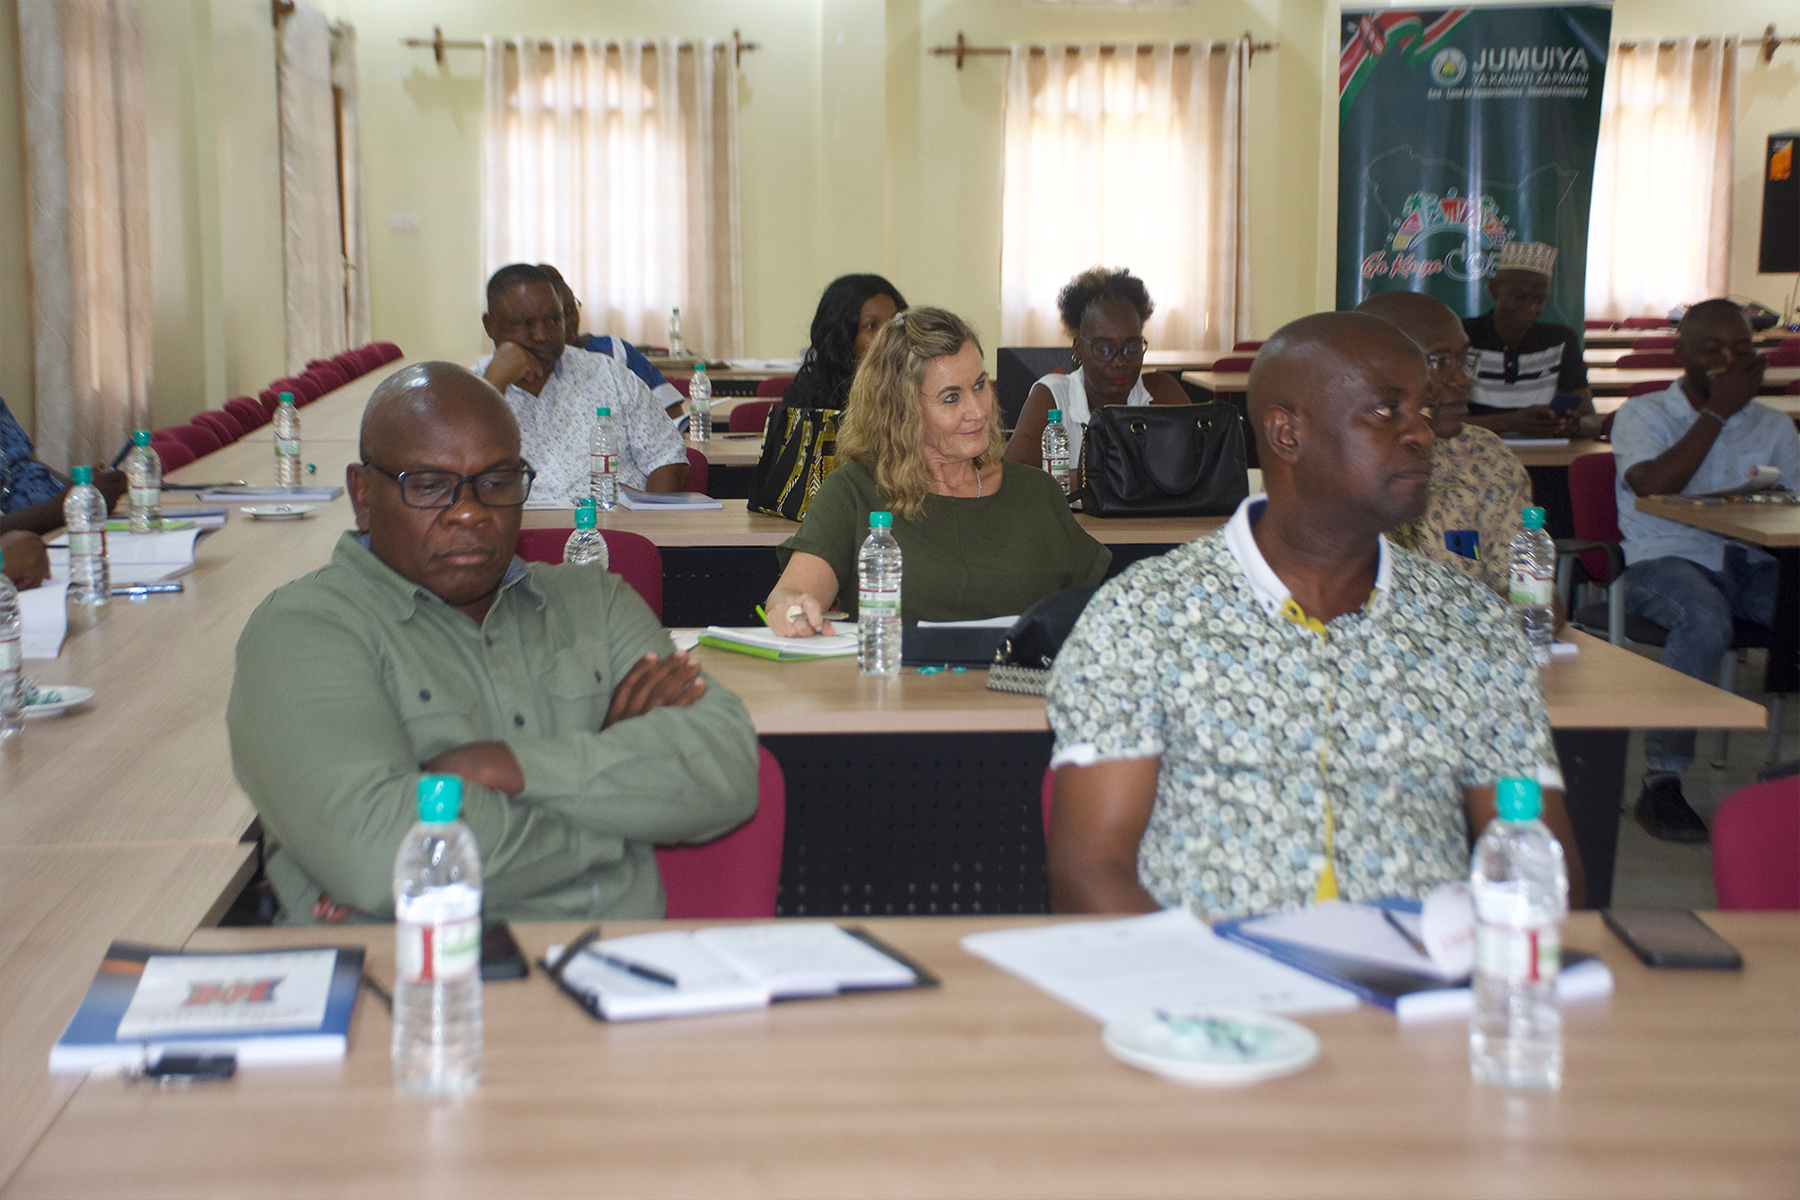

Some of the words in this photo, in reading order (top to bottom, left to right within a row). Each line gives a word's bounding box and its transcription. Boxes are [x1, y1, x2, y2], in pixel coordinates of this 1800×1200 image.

[1472, 46, 1589, 72] JUMUIYA
[1552, 72, 1589, 86] PWANI
[1361, 249, 1389, 279] Go
[1389, 252, 1443, 279] Kenya
